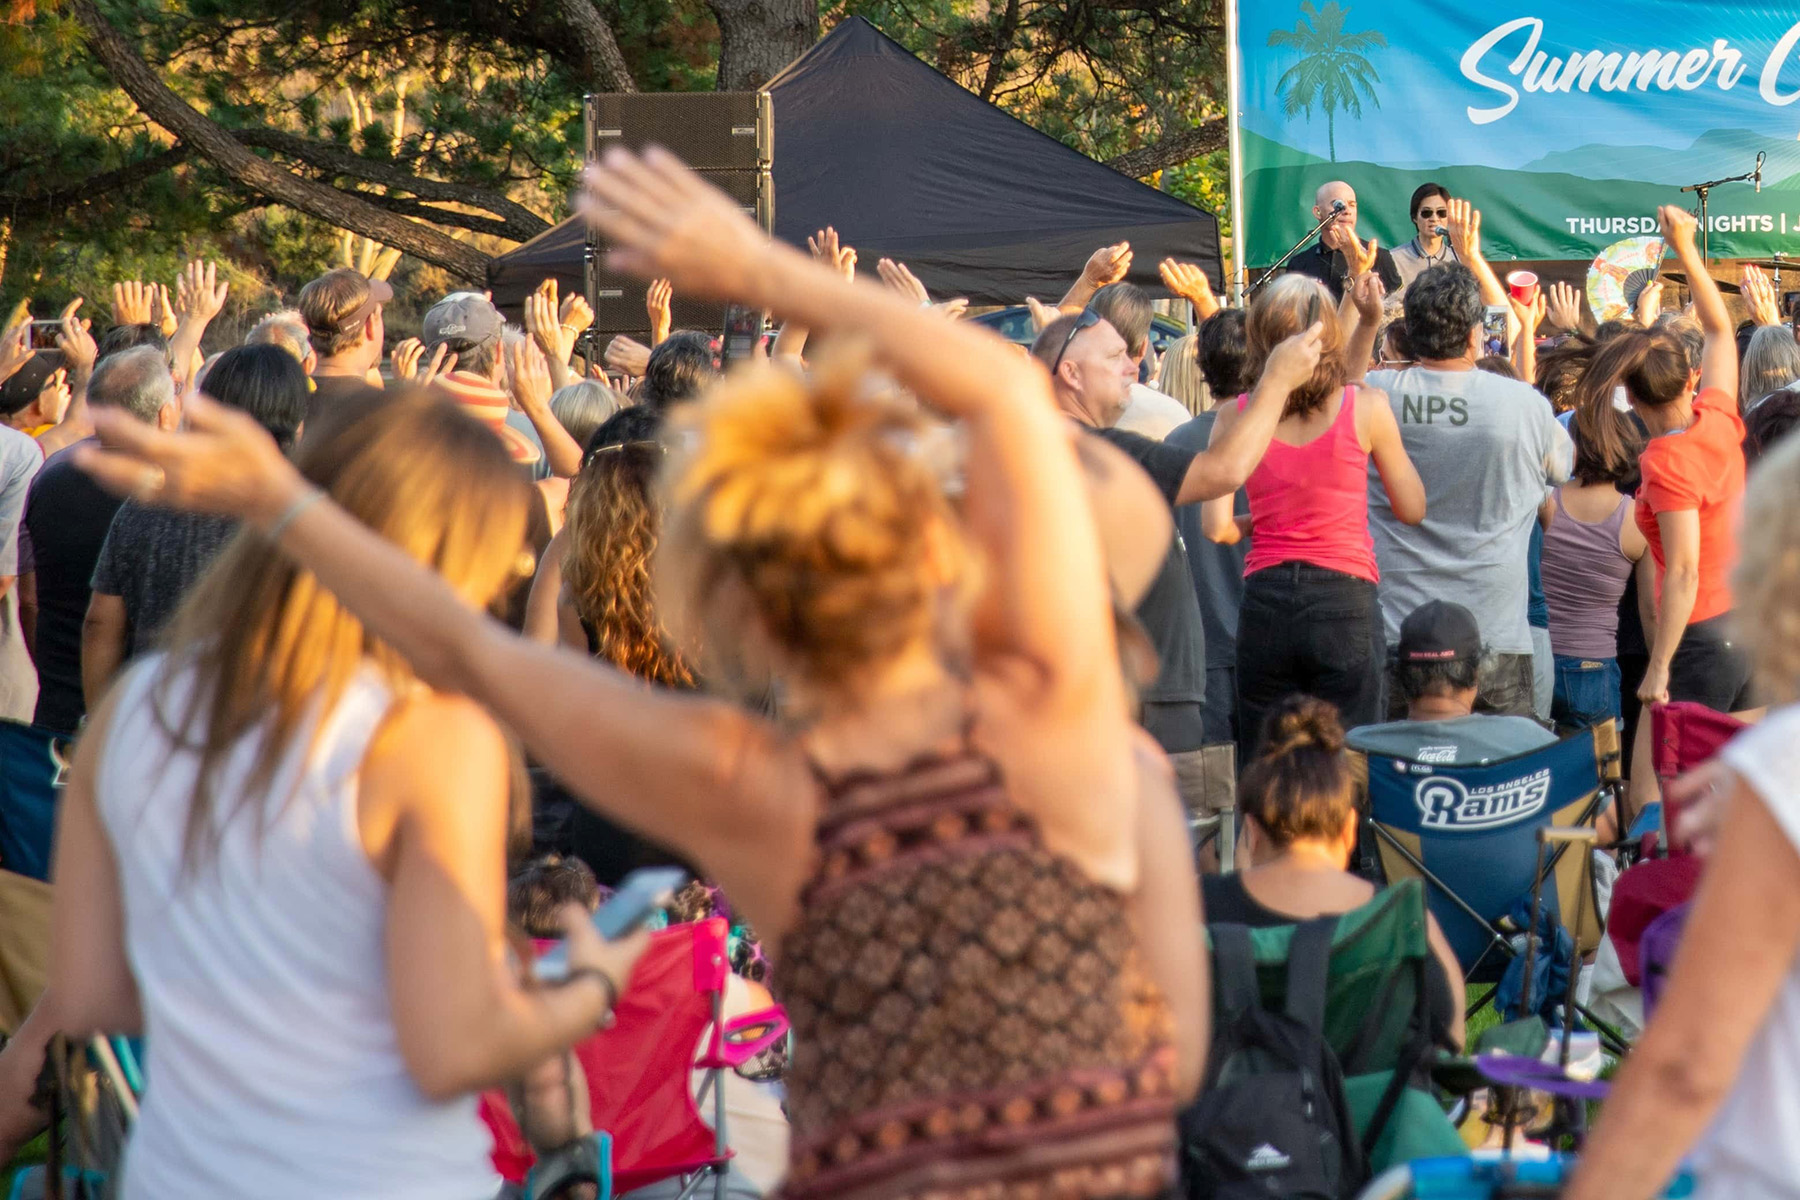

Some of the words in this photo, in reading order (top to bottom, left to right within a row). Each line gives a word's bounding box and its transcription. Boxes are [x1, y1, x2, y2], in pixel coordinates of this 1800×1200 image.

[1460, 17, 1747, 125] Summer
[1566, 217, 1662, 234] THURSD
[1402, 394, 1469, 426] NPS
[1471, 786, 1494, 795] LOS
[1497, 768, 1550, 792] ANGELES
[1415, 775, 1551, 830] Rams
